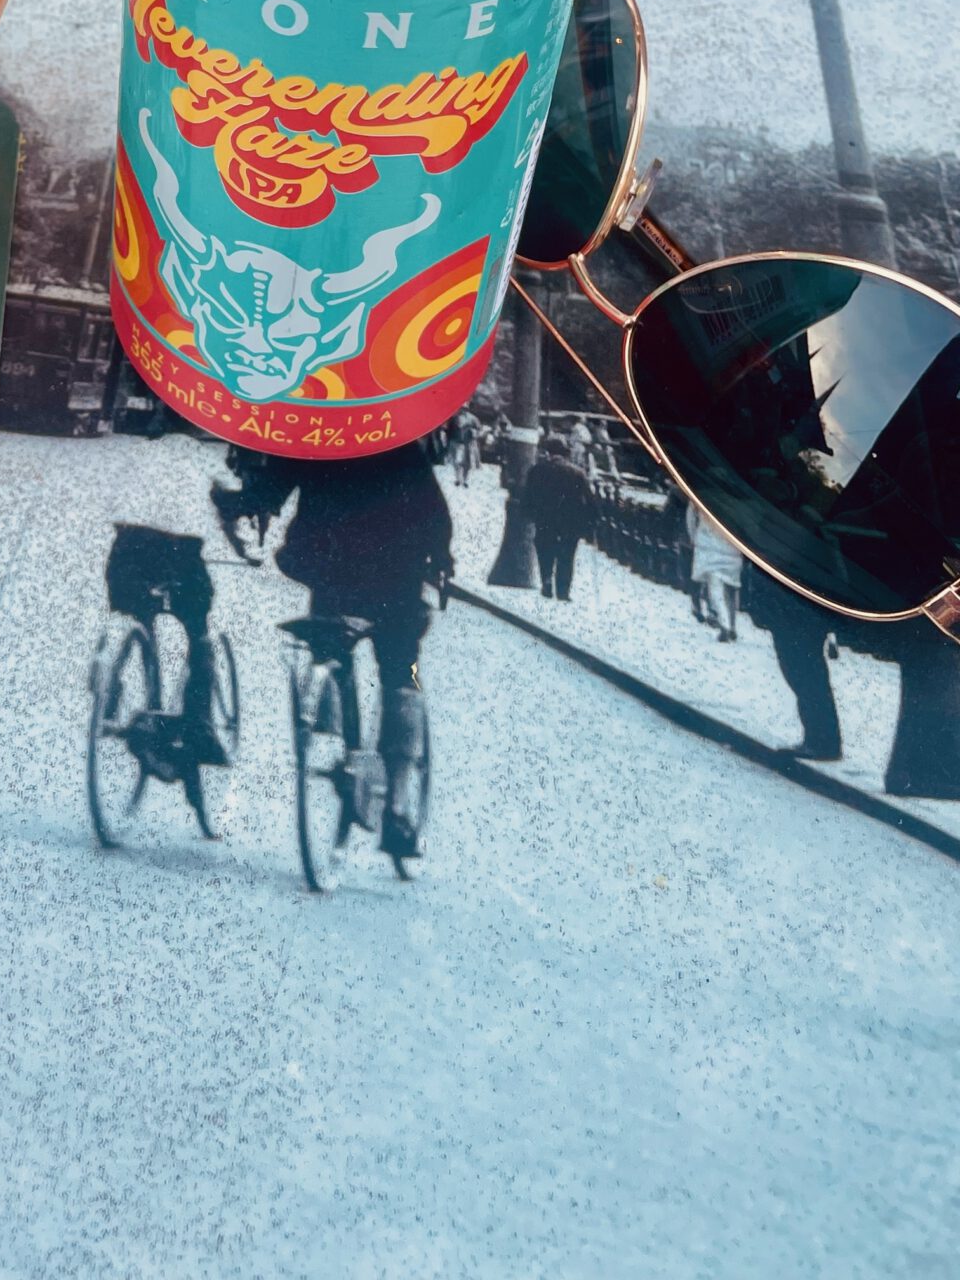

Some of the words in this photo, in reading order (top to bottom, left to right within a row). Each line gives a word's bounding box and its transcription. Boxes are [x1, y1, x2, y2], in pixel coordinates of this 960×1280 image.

[171, 68, 378, 192] Haze
[230, 156, 304, 206] IPA
[131, 323, 179, 375] HAZY
[130, 335, 163, 383] 355
[238, 416, 293, 445] Alc.
[301, 427, 346, 447] 4%
[354, 421, 397, 446] vol.
[197, 381, 323, 426] SESSION
[347, 410, 392, 426] IPA
